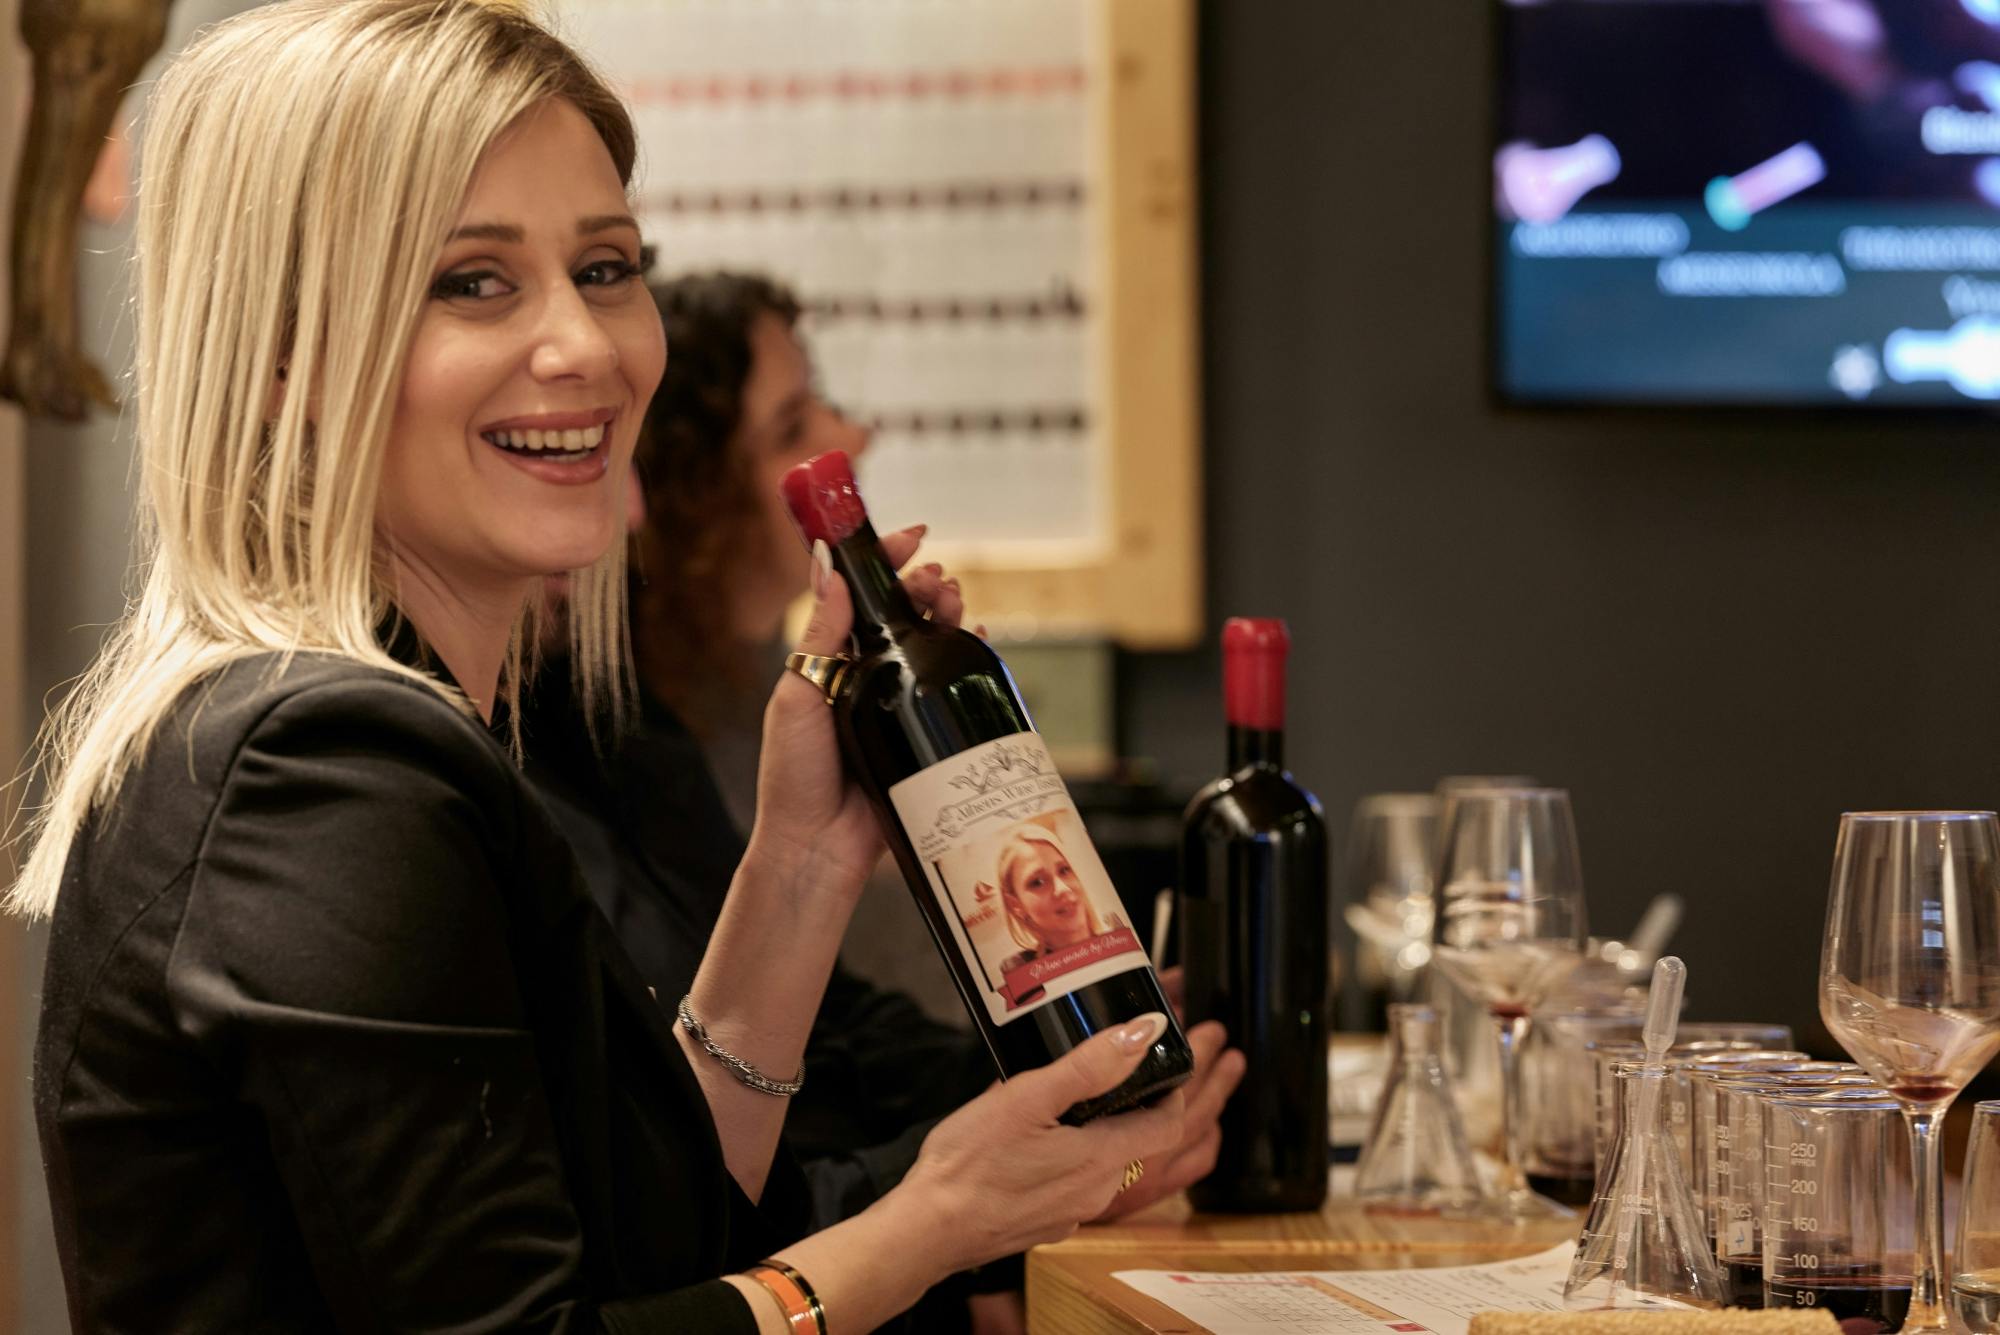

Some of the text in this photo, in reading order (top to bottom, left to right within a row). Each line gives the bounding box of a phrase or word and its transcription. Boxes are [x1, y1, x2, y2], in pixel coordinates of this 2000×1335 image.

[1791, 1142, 1816, 1158] 250
[1791, 1179, 1817, 1195] 200
[1793, 1217, 1818, 1232] 150
[1793, 1254, 1819, 1269] 100
[1796, 1290, 1816, 1306] 50
